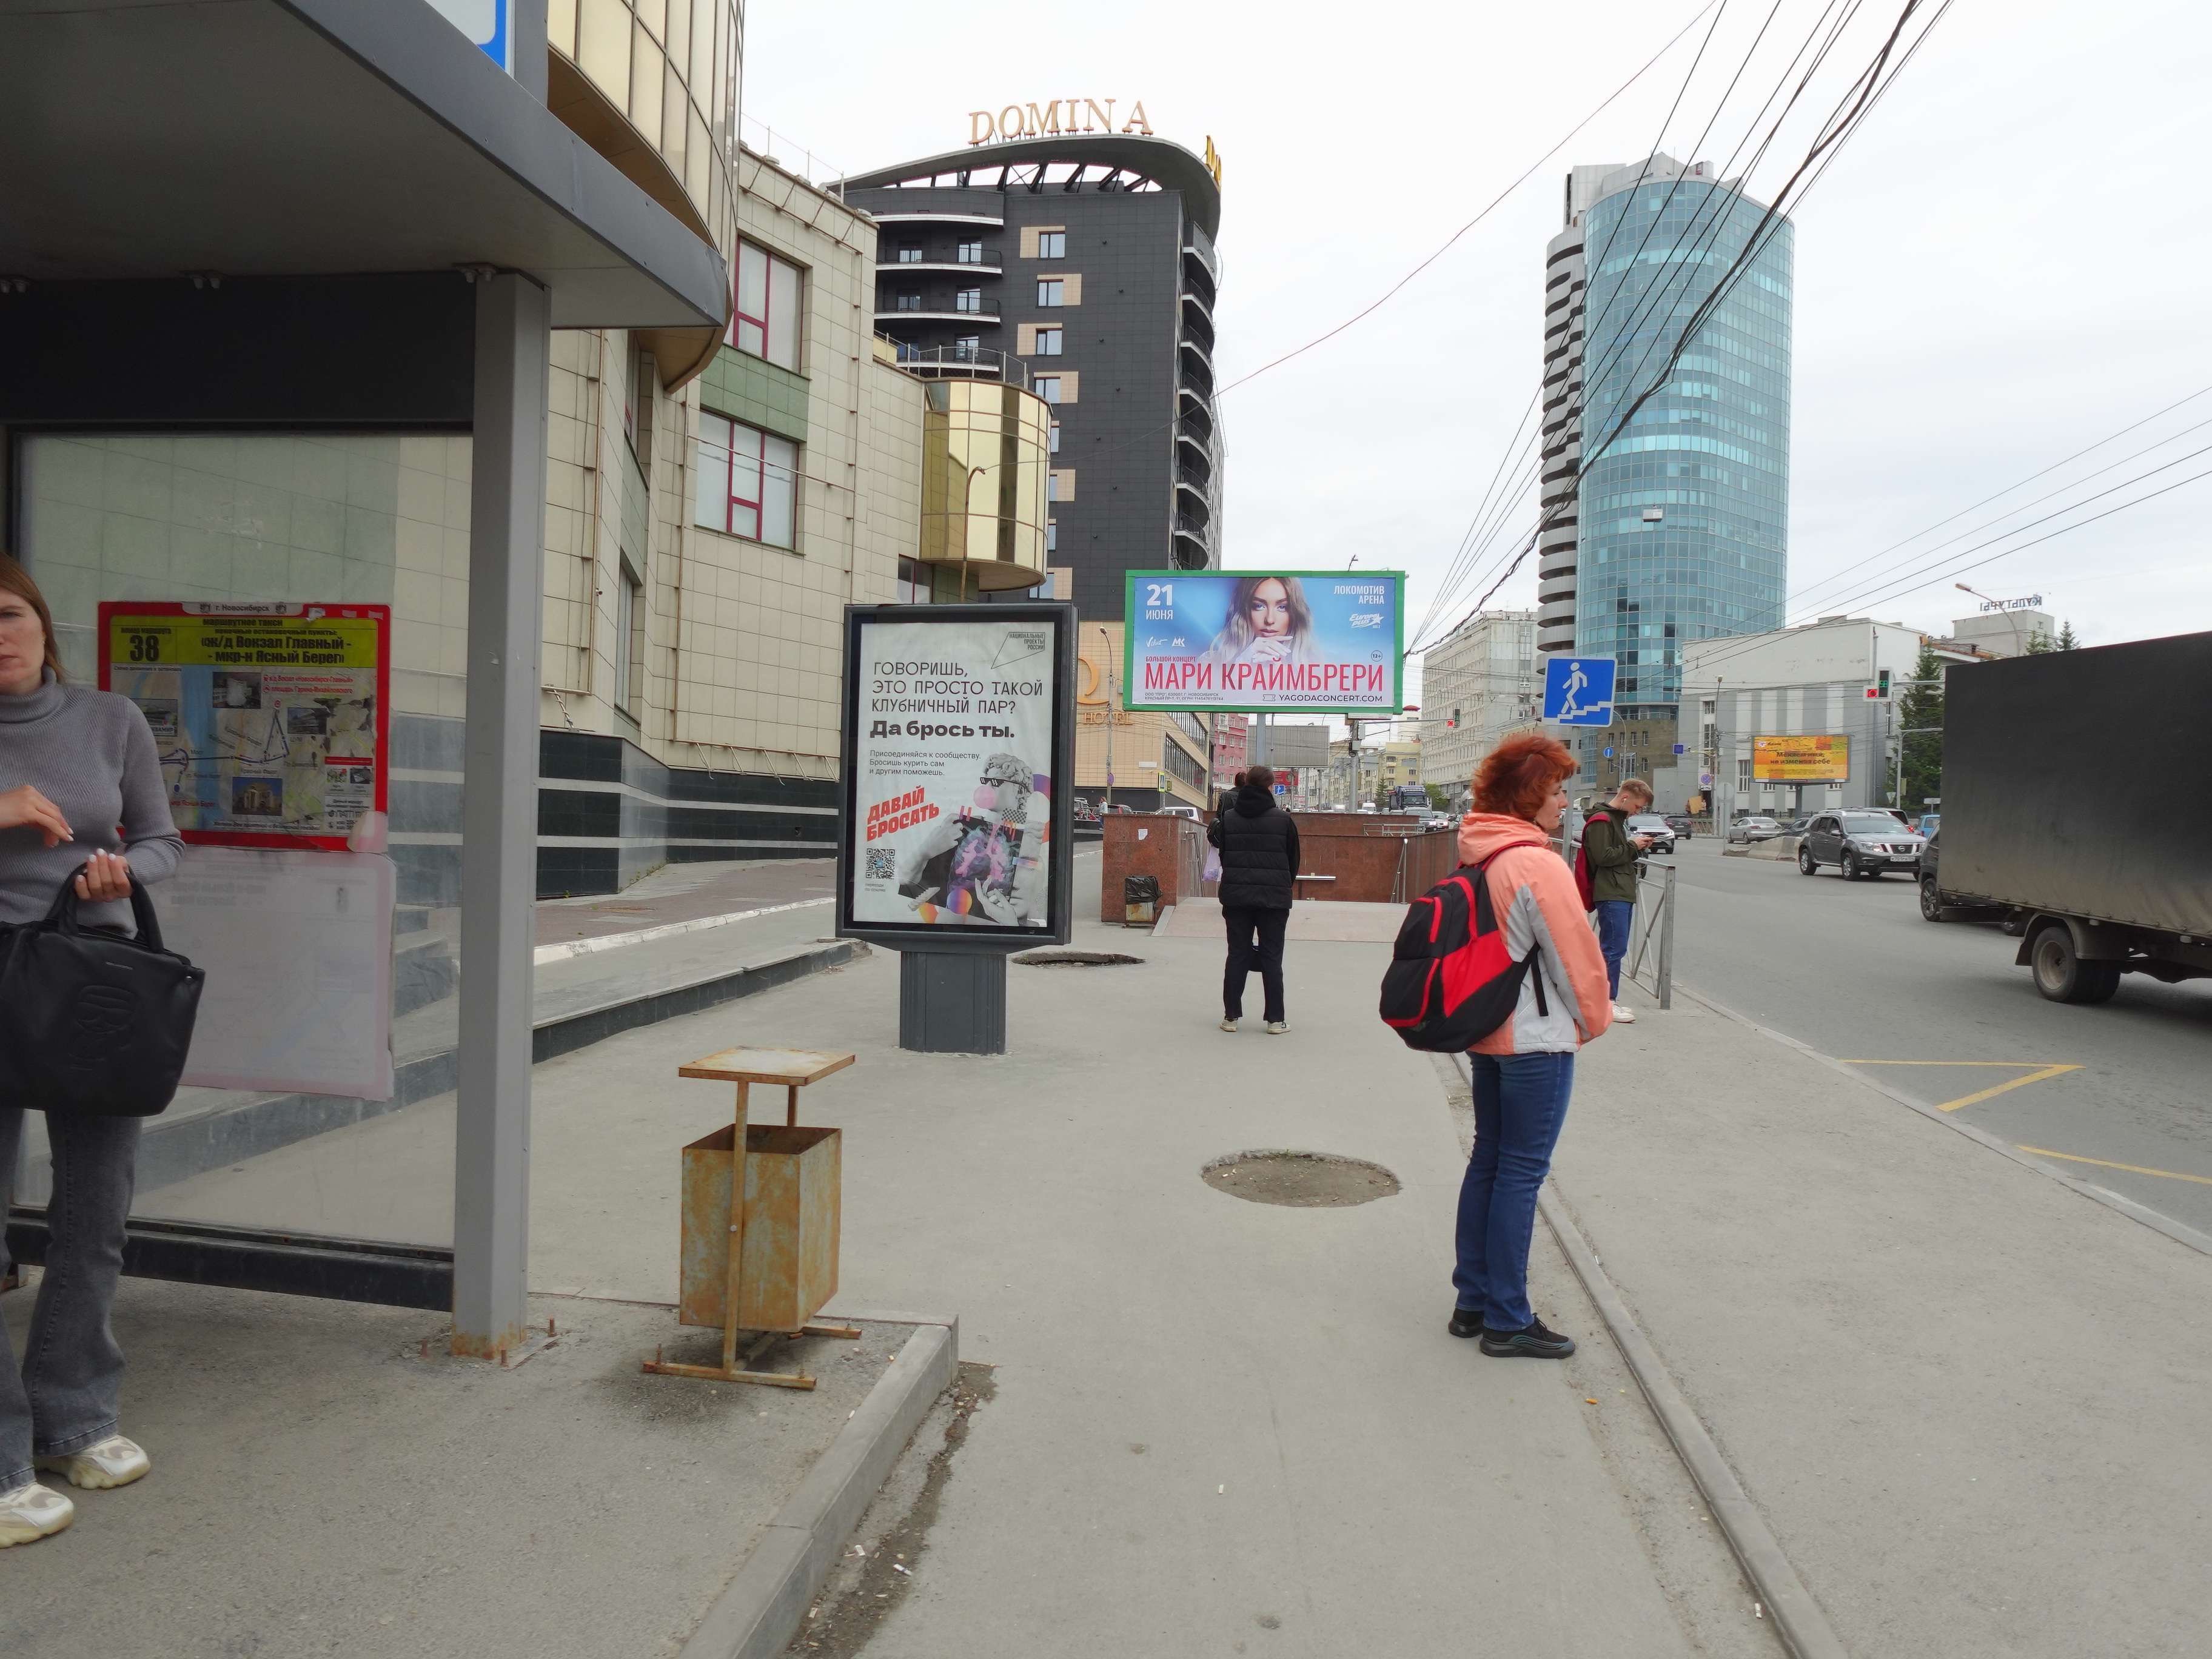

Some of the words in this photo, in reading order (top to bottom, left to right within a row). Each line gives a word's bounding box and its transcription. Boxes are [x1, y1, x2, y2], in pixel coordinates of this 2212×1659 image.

[968, 99, 1153, 145] DOMINA
[1147, 584, 1173, 606] 21
[1334, 585, 1384, 595] ЛОКОМОТИВ
[1358, 595, 1384, 605] АРЕНА
[222, 604, 270, 612] Новосибирск
[1146, 609, 1173, 620] ИЮНЯ
[130, 635, 159, 662] 38
[236, 636, 283, 649] Вокзал
[286, 637, 344, 649] Главный
[215, 651, 253, 663] мкр-н
[256, 649, 299, 663] Ясный
[874, 662, 968, 677] ГОВОРИШЬ,
[1145, 663, 1212, 689] МАРИ
[1222, 657, 1383, 691] КРАЙМБРЕРИ
[873, 680, 907, 694] ЭТО
[915, 680, 984, 695] ПРОСТО
[994, 679, 1042, 695] ТАКОЙ
[978, 700, 1016, 714] ПАР?
[870, 720, 902, 739] Да
[906, 720, 974, 740] брось
[979, 724, 1014, 738] ты.
[870, 749, 927, 759] Присоединяйся
[935, 751, 981, 760] сообществу.
[870, 759, 902, 767] Бросишь
[903, 760, 929, 769] курить
[867, 785, 925, 824] ДАВАЙ
[866, 803, 940, 842] БРОСАТЬ
